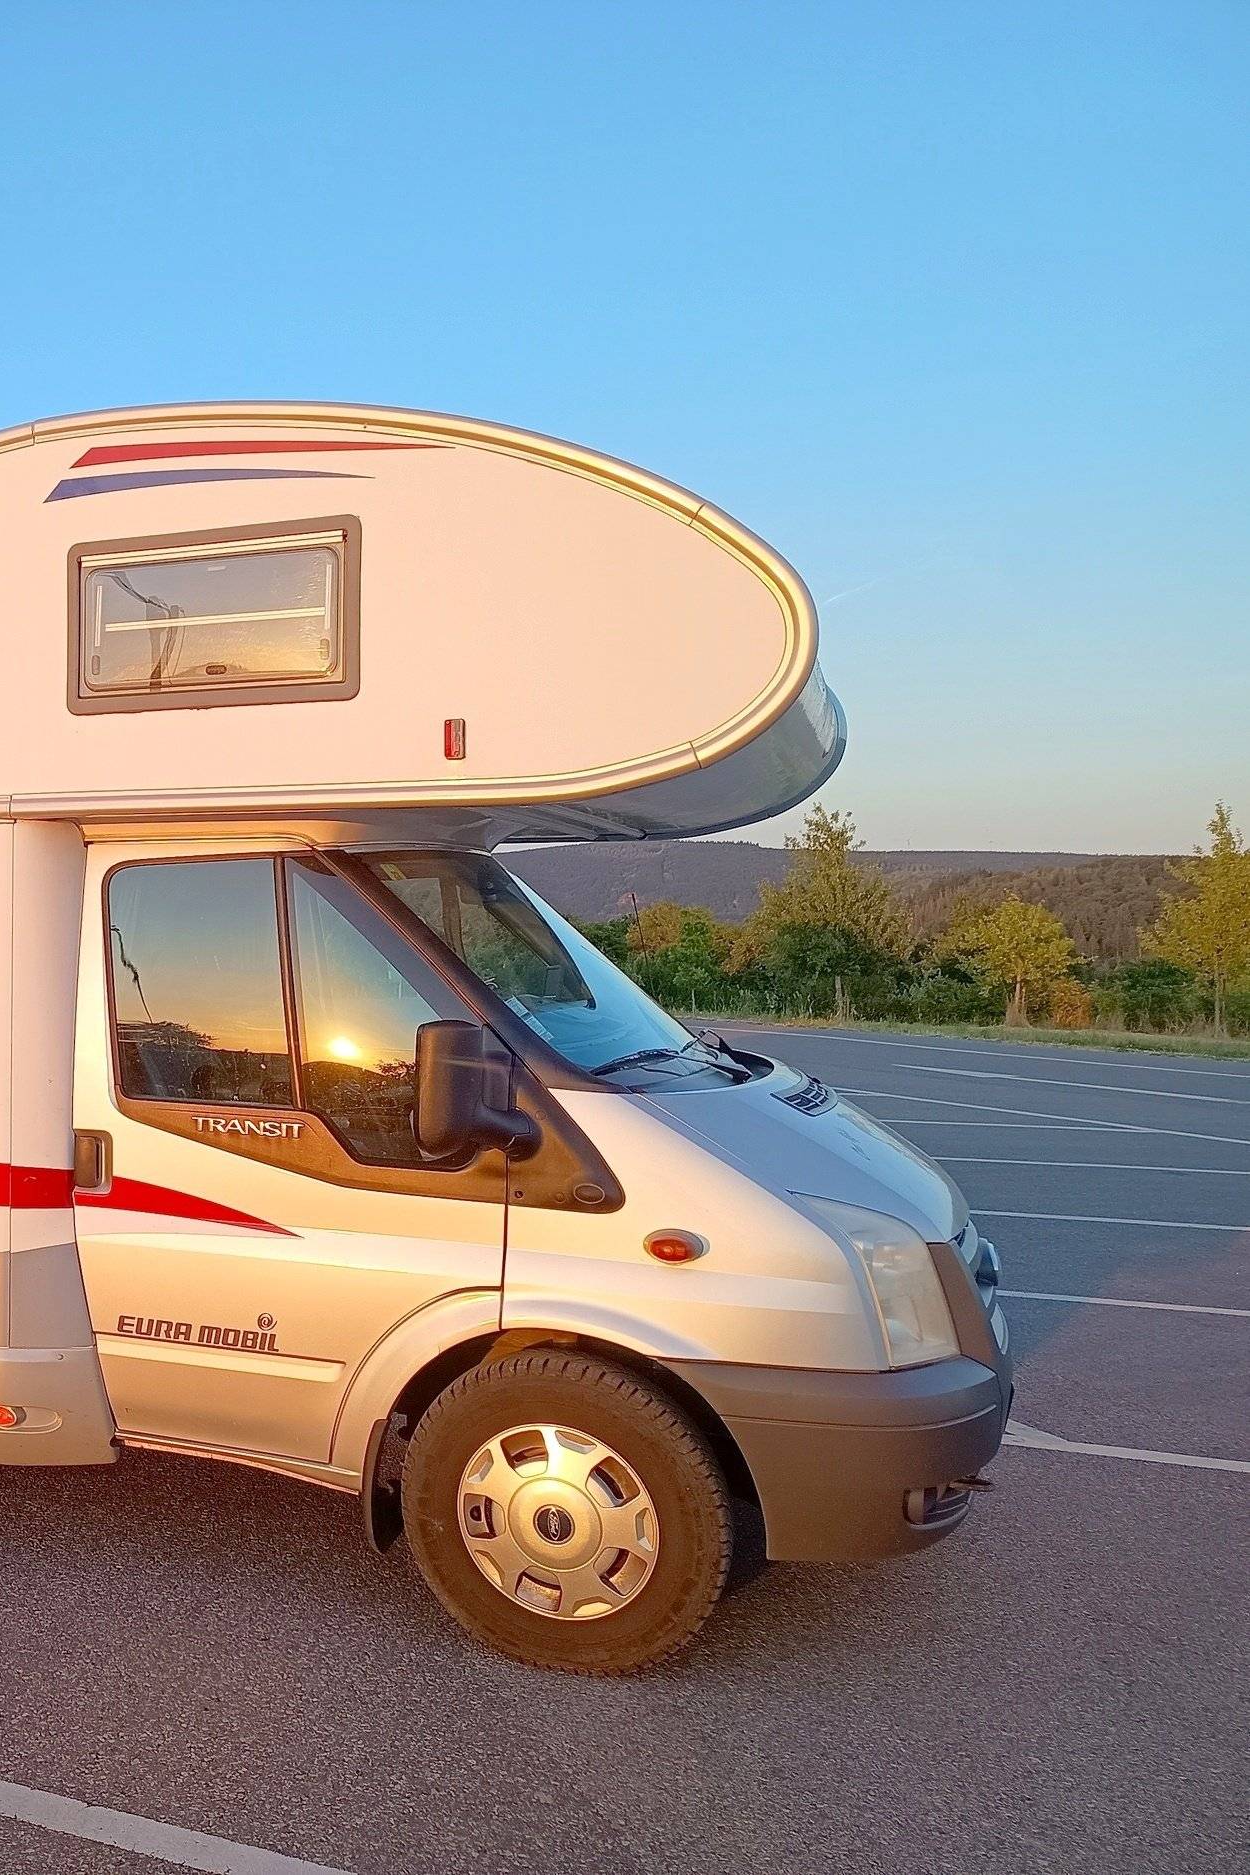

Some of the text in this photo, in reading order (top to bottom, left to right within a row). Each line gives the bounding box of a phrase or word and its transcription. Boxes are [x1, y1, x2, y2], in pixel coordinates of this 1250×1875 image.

[192, 1116, 304, 1138] TRANSIT
[117, 1315, 279, 1352] EURA MOBIL
